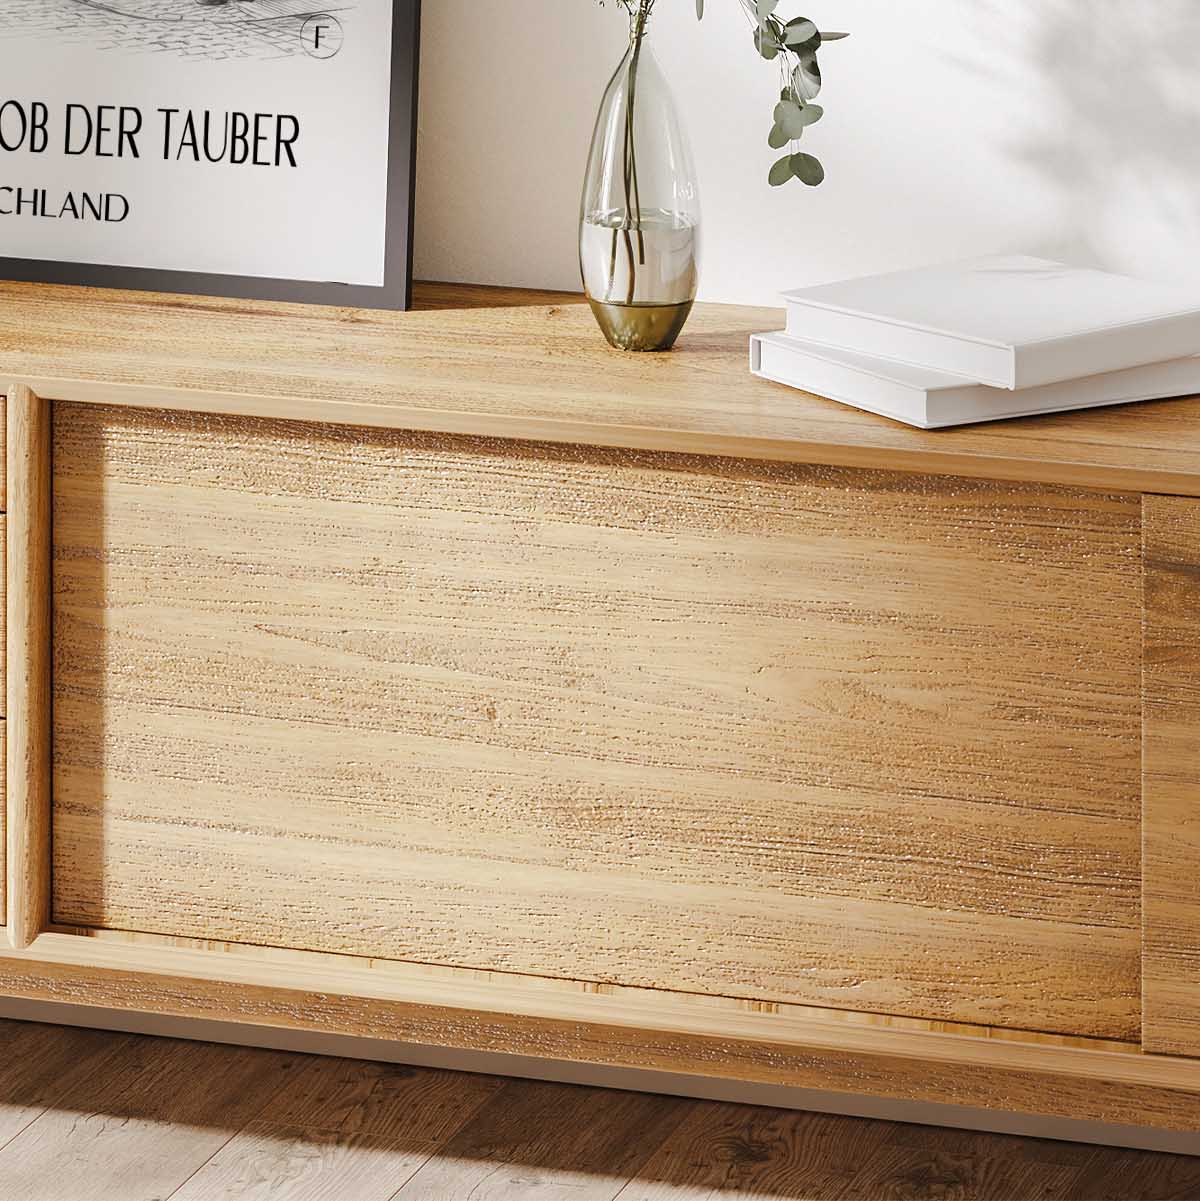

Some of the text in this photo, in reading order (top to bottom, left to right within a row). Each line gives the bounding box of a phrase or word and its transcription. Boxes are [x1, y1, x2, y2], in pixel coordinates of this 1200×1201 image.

[314, 25, 330, 49] F
[63, 103, 143, 159] DER
[156, 108, 300, 168] TAUBER
